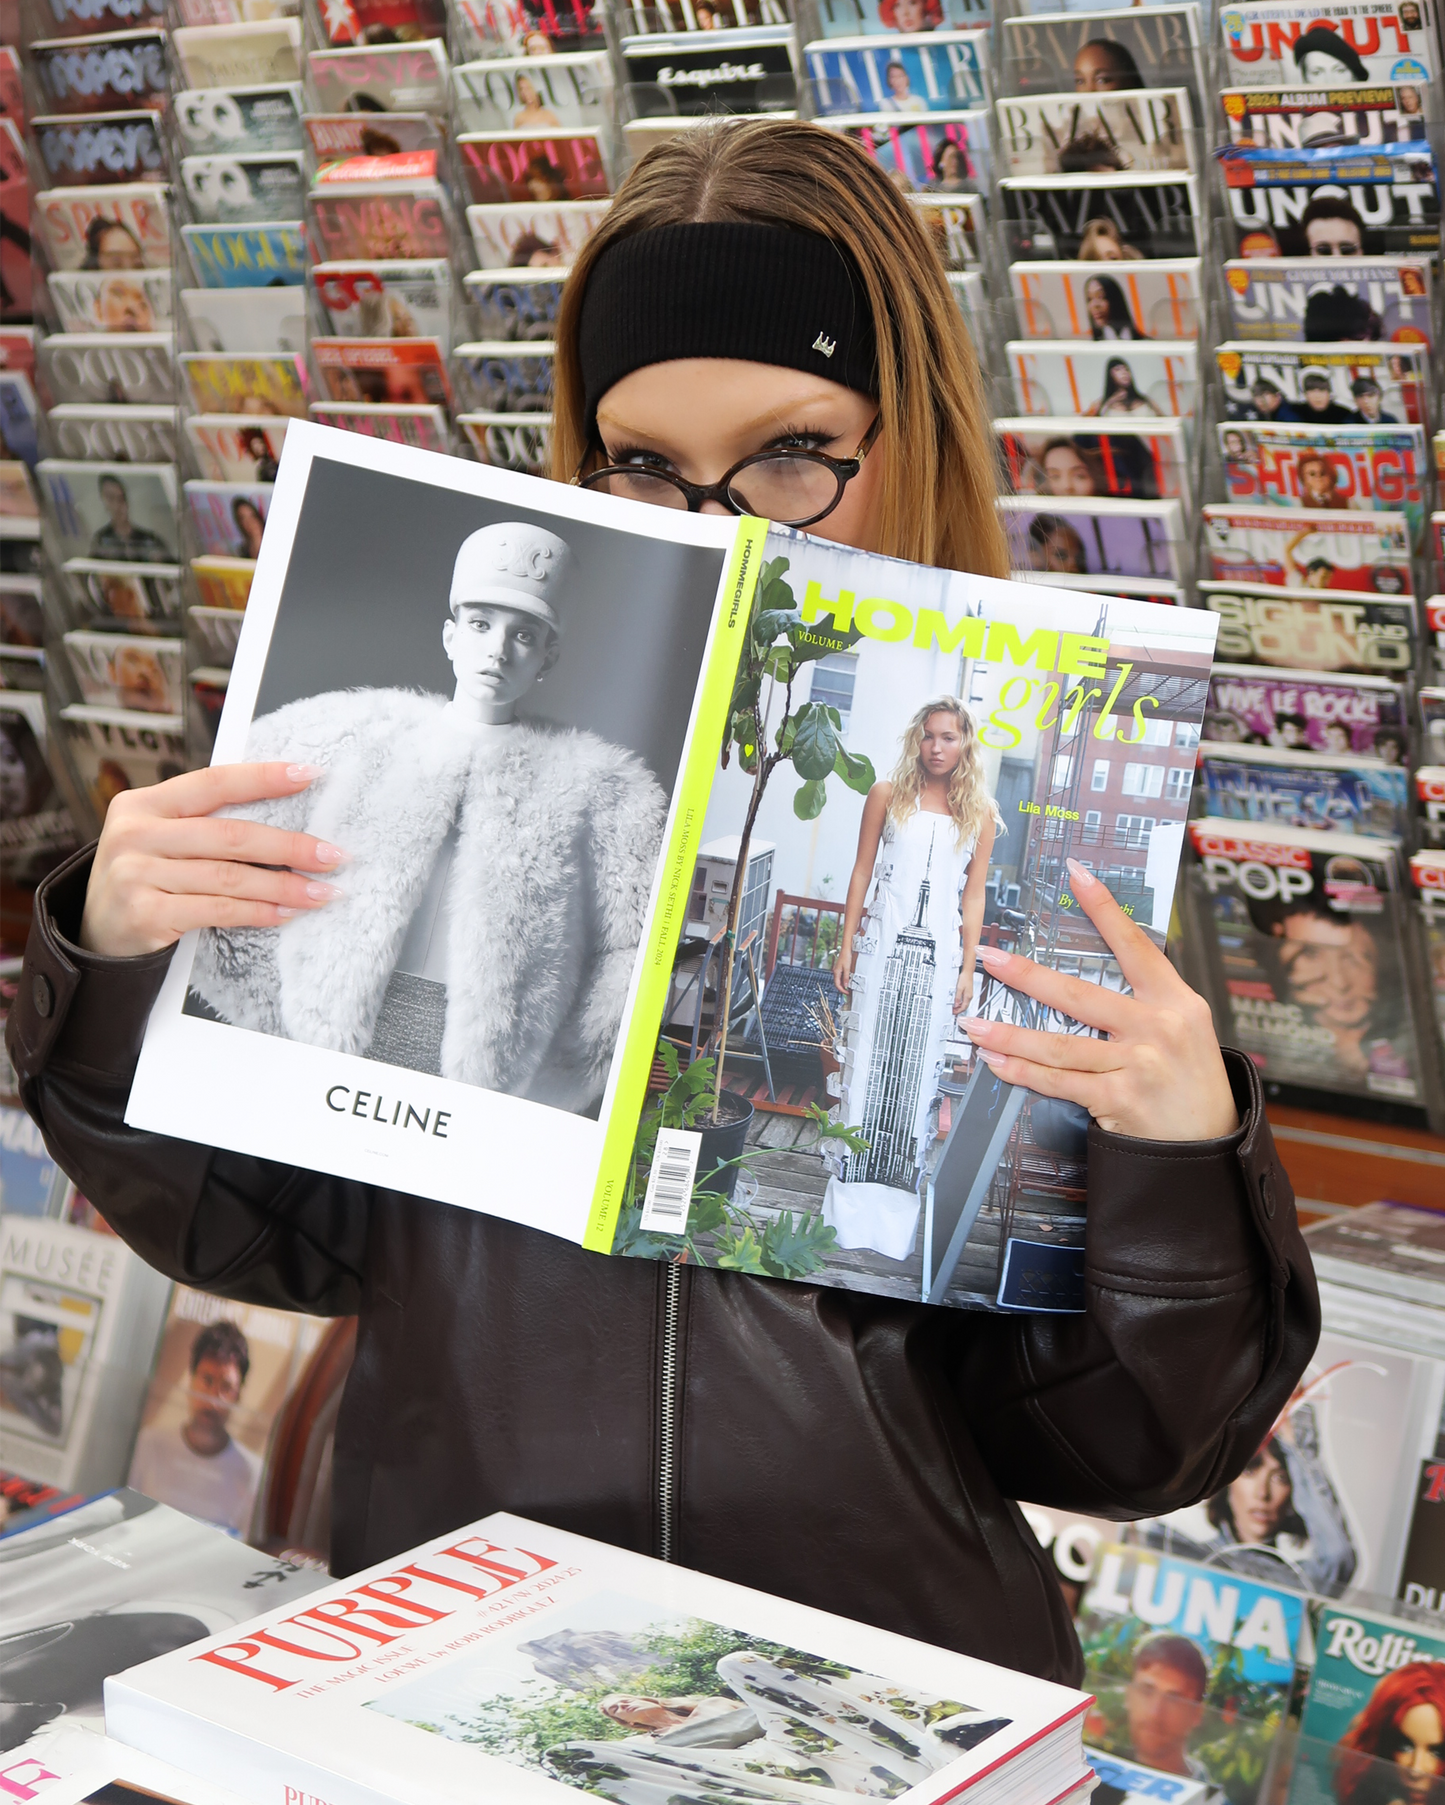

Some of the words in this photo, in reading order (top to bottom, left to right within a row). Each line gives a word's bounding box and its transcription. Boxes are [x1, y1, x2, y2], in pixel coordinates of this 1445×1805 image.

[657, 62, 767, 89] Esquire
[1246, 95, 1280, 109] 2024
[1281, 93, 1327, 106] ALBUM
[1329, 88, 1394, 105] PREVIEW!
[1006, 97, 1179, 152] BAZAAR
[1228, 111, 1421, 149] UNUT
[46, 199, 165, 244] SPUR
[1014, 185, 1190, 236] BAZAAR
[1020, 273, 1199, 337] ELLE
[1018, 354, 1196, 416] ELE
[1002, 432, 1183, 496] ELE
[728, 538, 753, 629] HOMMEGIRLS
[800, 580, 1111, 680] HOMME
[1208, 594, 1366, 636] SIGHT
[1356, 623, 1409, 638] AND
[798, 630, 844, 651] VOLUME
[1214, 623, 1411, 670] SOUND
[977, 663, 1160, 750] girls
[1215, 683, 1267, 719] VIVE
[1272, 688, 1299, 715] LE
[1302, 690, 1379, 722] ROCK!
[683, 807, 695, 828] LILA
[1018, 800, 1041, 815] Lila
[1044, 804, 1081, 822] Moss
[675, 855, 686, 867] BY
[676, 829, 691, 854] MOSS
[1200, 837, 1309, 868] CLASSIC
[670, 867, 683, 891] NICK
[1058, 893, 1074, 910] By
[1202, 854, 1315, 904] POP
[663, 891, 677, 919] SETHI
[325, 1084, 452, 1139] CELINE
[598, 1179, 615, 1221] VOLUME
[3, 1232, 116, 1294] MUSÉE
[189, 1536, 560, 1693] PURPLE
[1085, 1550, 1292, 1661] LUNA
[373, 1656, 432, 1685] LOEWE
[429, 1646, 452, 1663] by
[444, 1631, 484, 1653] ROBI
[479, 1595, 560, 1636] RODRIGUEZ
[295, 1682, 331, 1700] THE
[333, 1663, 374, 1688] MAGIC
[373, 1644, 418, 1666] ISSUE
